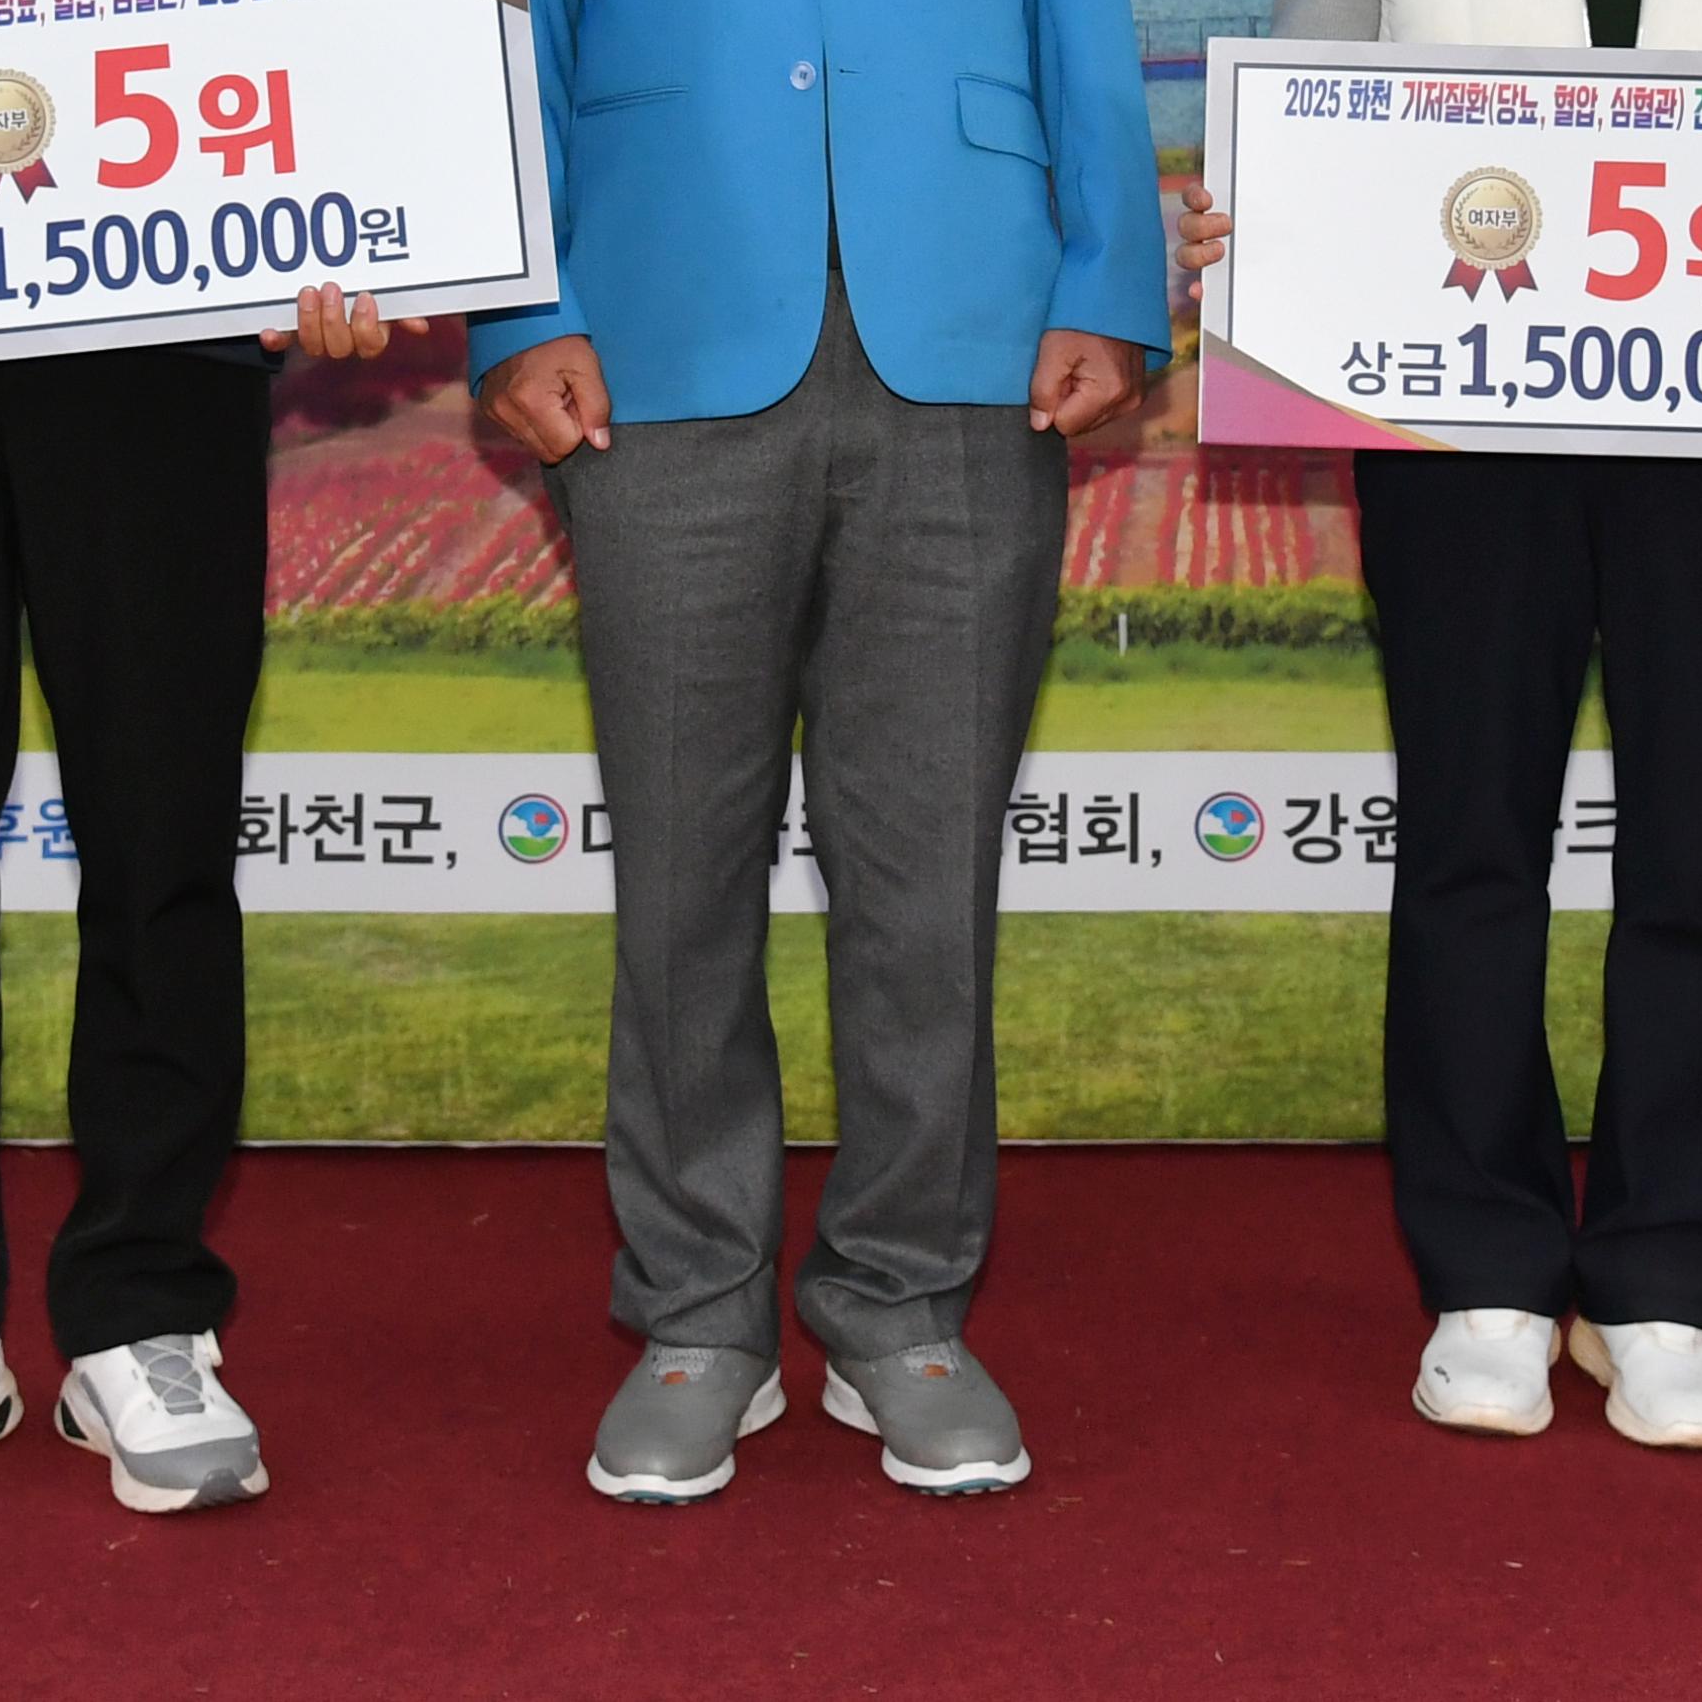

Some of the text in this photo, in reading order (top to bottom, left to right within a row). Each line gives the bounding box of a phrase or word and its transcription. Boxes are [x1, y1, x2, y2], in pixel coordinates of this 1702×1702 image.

[1284, 78, 1341, 118] 2025
[1347, 79, 1393, 121] 화천
[1553, 84, 1603, 132] 혈압,
[1610, 86, 1684, 131] 심혈관)
[1468, 209, 1517, 227] 여자부
